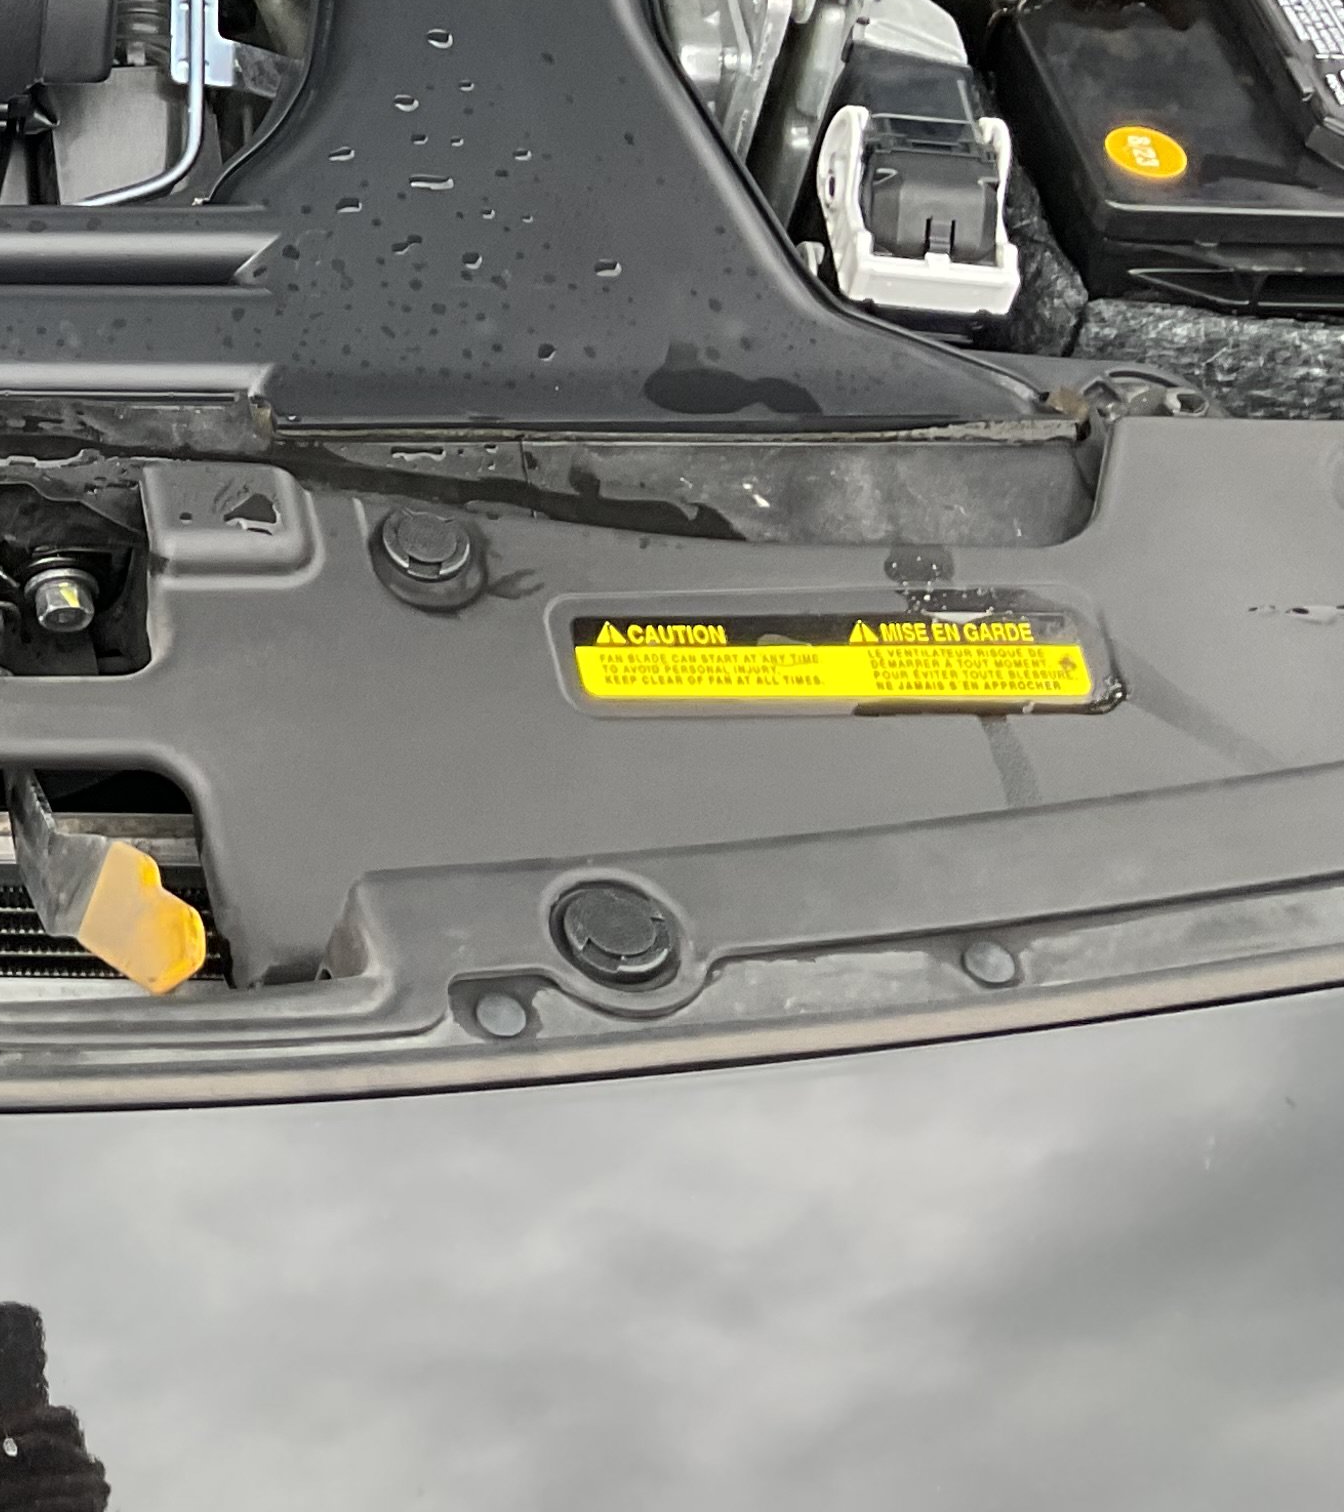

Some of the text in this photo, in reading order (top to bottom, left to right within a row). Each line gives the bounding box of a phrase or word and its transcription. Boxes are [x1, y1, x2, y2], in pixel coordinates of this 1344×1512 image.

[627, 624, 728, 645] CAUTION
[879, 622, 1034, 643] MISE EN GARDE
[599, 653, 623, 663] FAN
[627, 653, 667, 664] BLADE
[671, 653, 697, 664] CAN
[701, 654, 738, 664] START
[743, 654, 757, 664] AT
[761, 653, 786, 664] ANY
[867, 648, 1045, 658] LE VENTILATEUR RISQUE DE
[871, 658, 940, 669] DÉMARRER
[957, 658, 988, 669] TOUT
[602, 664, 618, 674] TO
[623, 664, 660, 674] AVOID
[664, 664, 730, 675] PERSONAL
[873, 669, 908, 680] POUR
[913, 668, 958, 679] ÉVITER
[962, 669, 1003, 680] TOUTE
[604, 675, 637, 685] KEEP
[642, 675, 683, 685] CLEAR
[687, 675, 703, 685] OF
[708, 675, 733, 685] FAN
[737, 675, 750, 685] AT
[756, 675, 779, 685] ALL
[876, 681, 893, 691] NE
[898, 681, 945, 691] JAMAIS
[984, 681, 1062, 691] APPROCHER
